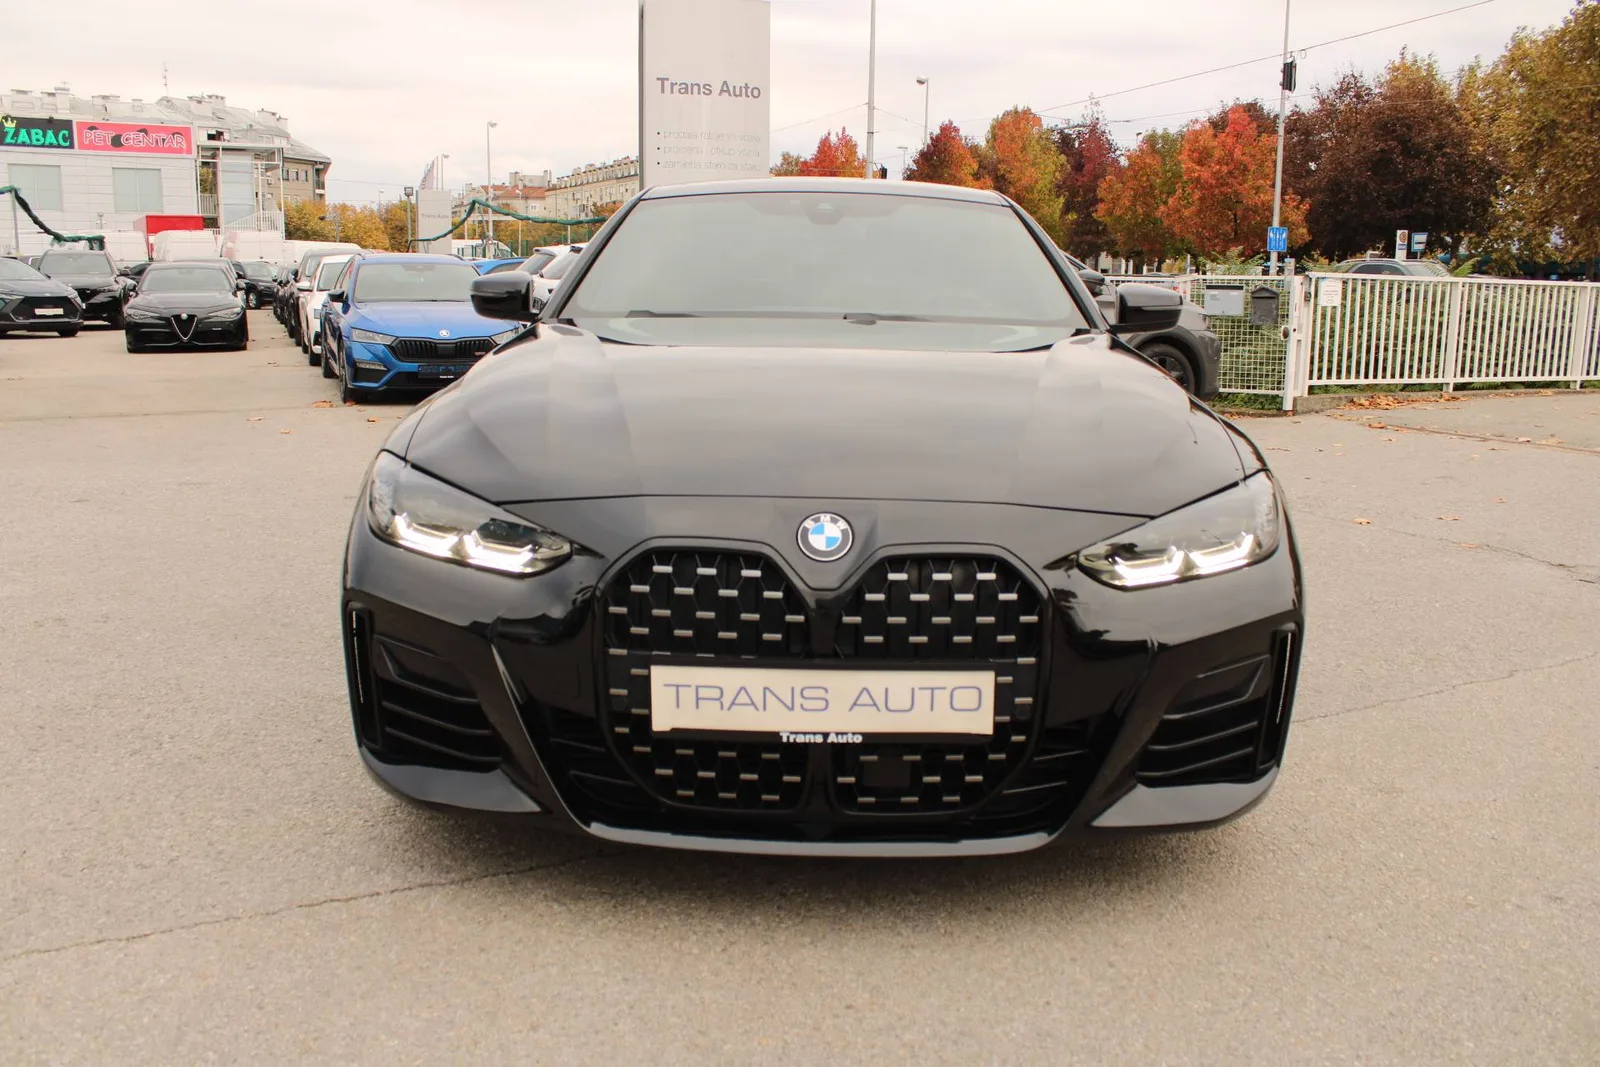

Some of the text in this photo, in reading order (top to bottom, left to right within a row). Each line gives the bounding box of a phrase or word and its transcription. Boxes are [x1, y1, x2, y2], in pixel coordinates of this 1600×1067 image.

[656, 77, 761, 99] Trans Auto
[83, 129, 187, 149] PET CENTAR
[804, 515, 848, 534] BMW
[663, 683, 983, 713] TRANS AUTO
[780, 731, 863, 744] Trans Auto
